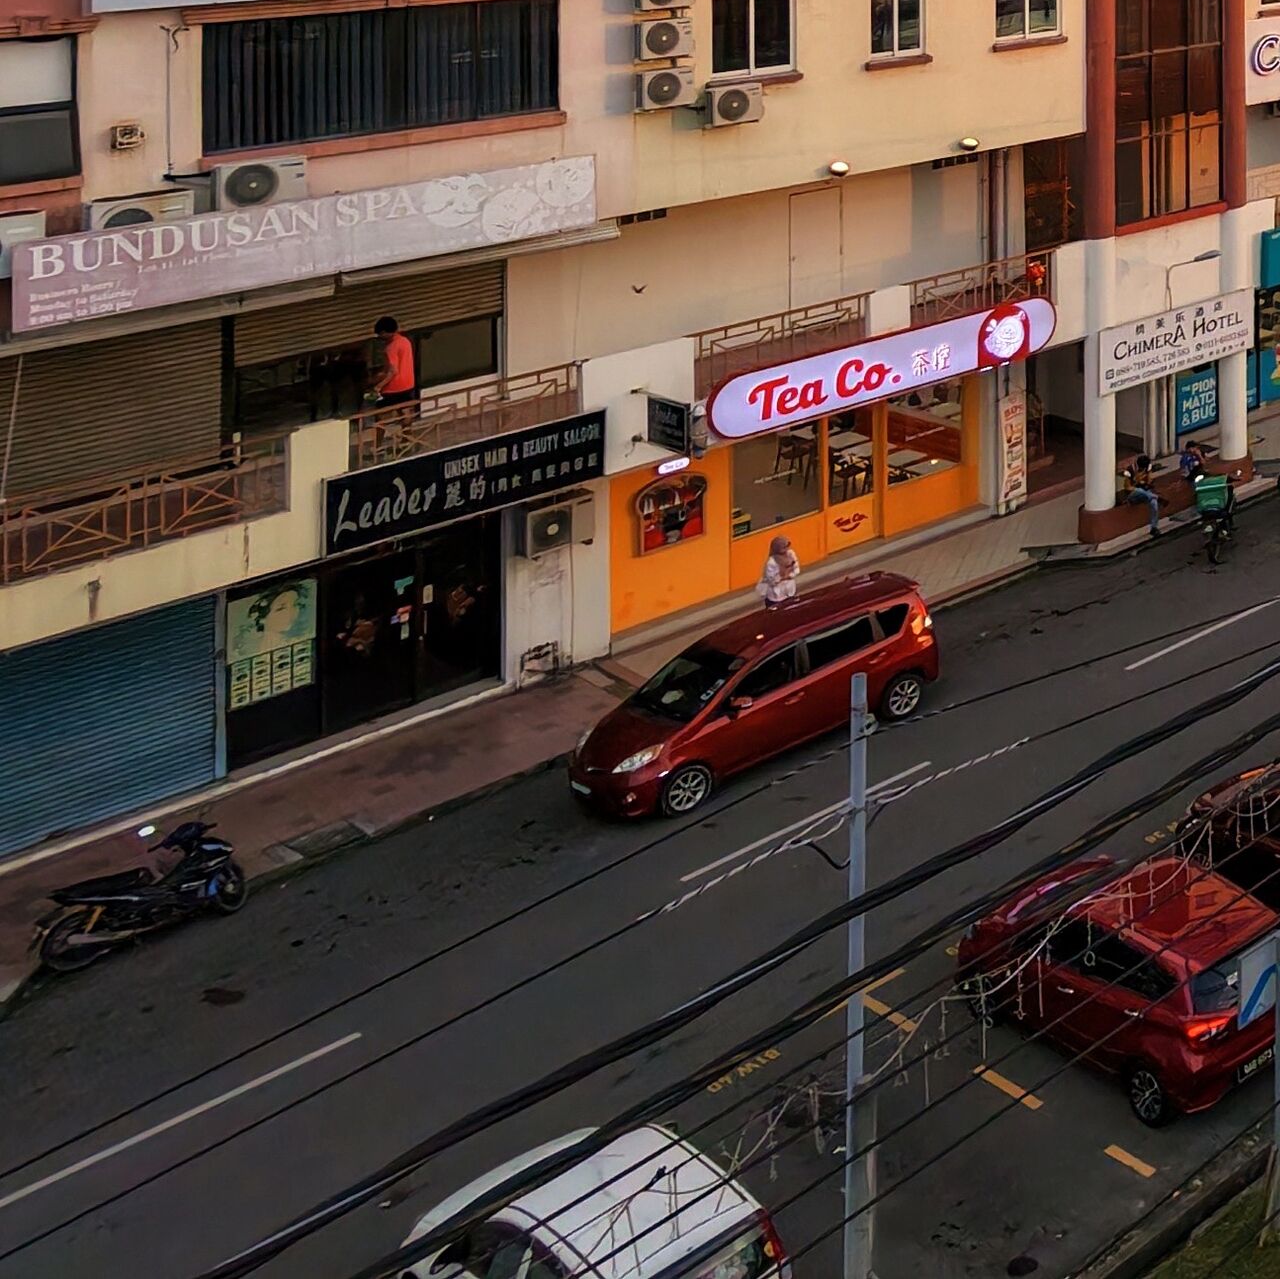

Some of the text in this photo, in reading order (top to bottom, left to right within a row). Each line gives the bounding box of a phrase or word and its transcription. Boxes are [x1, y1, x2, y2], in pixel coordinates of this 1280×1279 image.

[28, 203, 320, 280] BUNDUSAN
[336, 189, 418, 227] SPA
[1113, 325, 1186, 360] CHIMERA
[1193, 312, 1244, 338] HOTEL
[747, 358, 902, 422] Tea Co.
[444, 454, 480, 479] UNISEX
[484, 447, 508, 468] HAIR
[522, 433, 560, 459] BEAUTY
[333, 477, 437, 543] Leader
